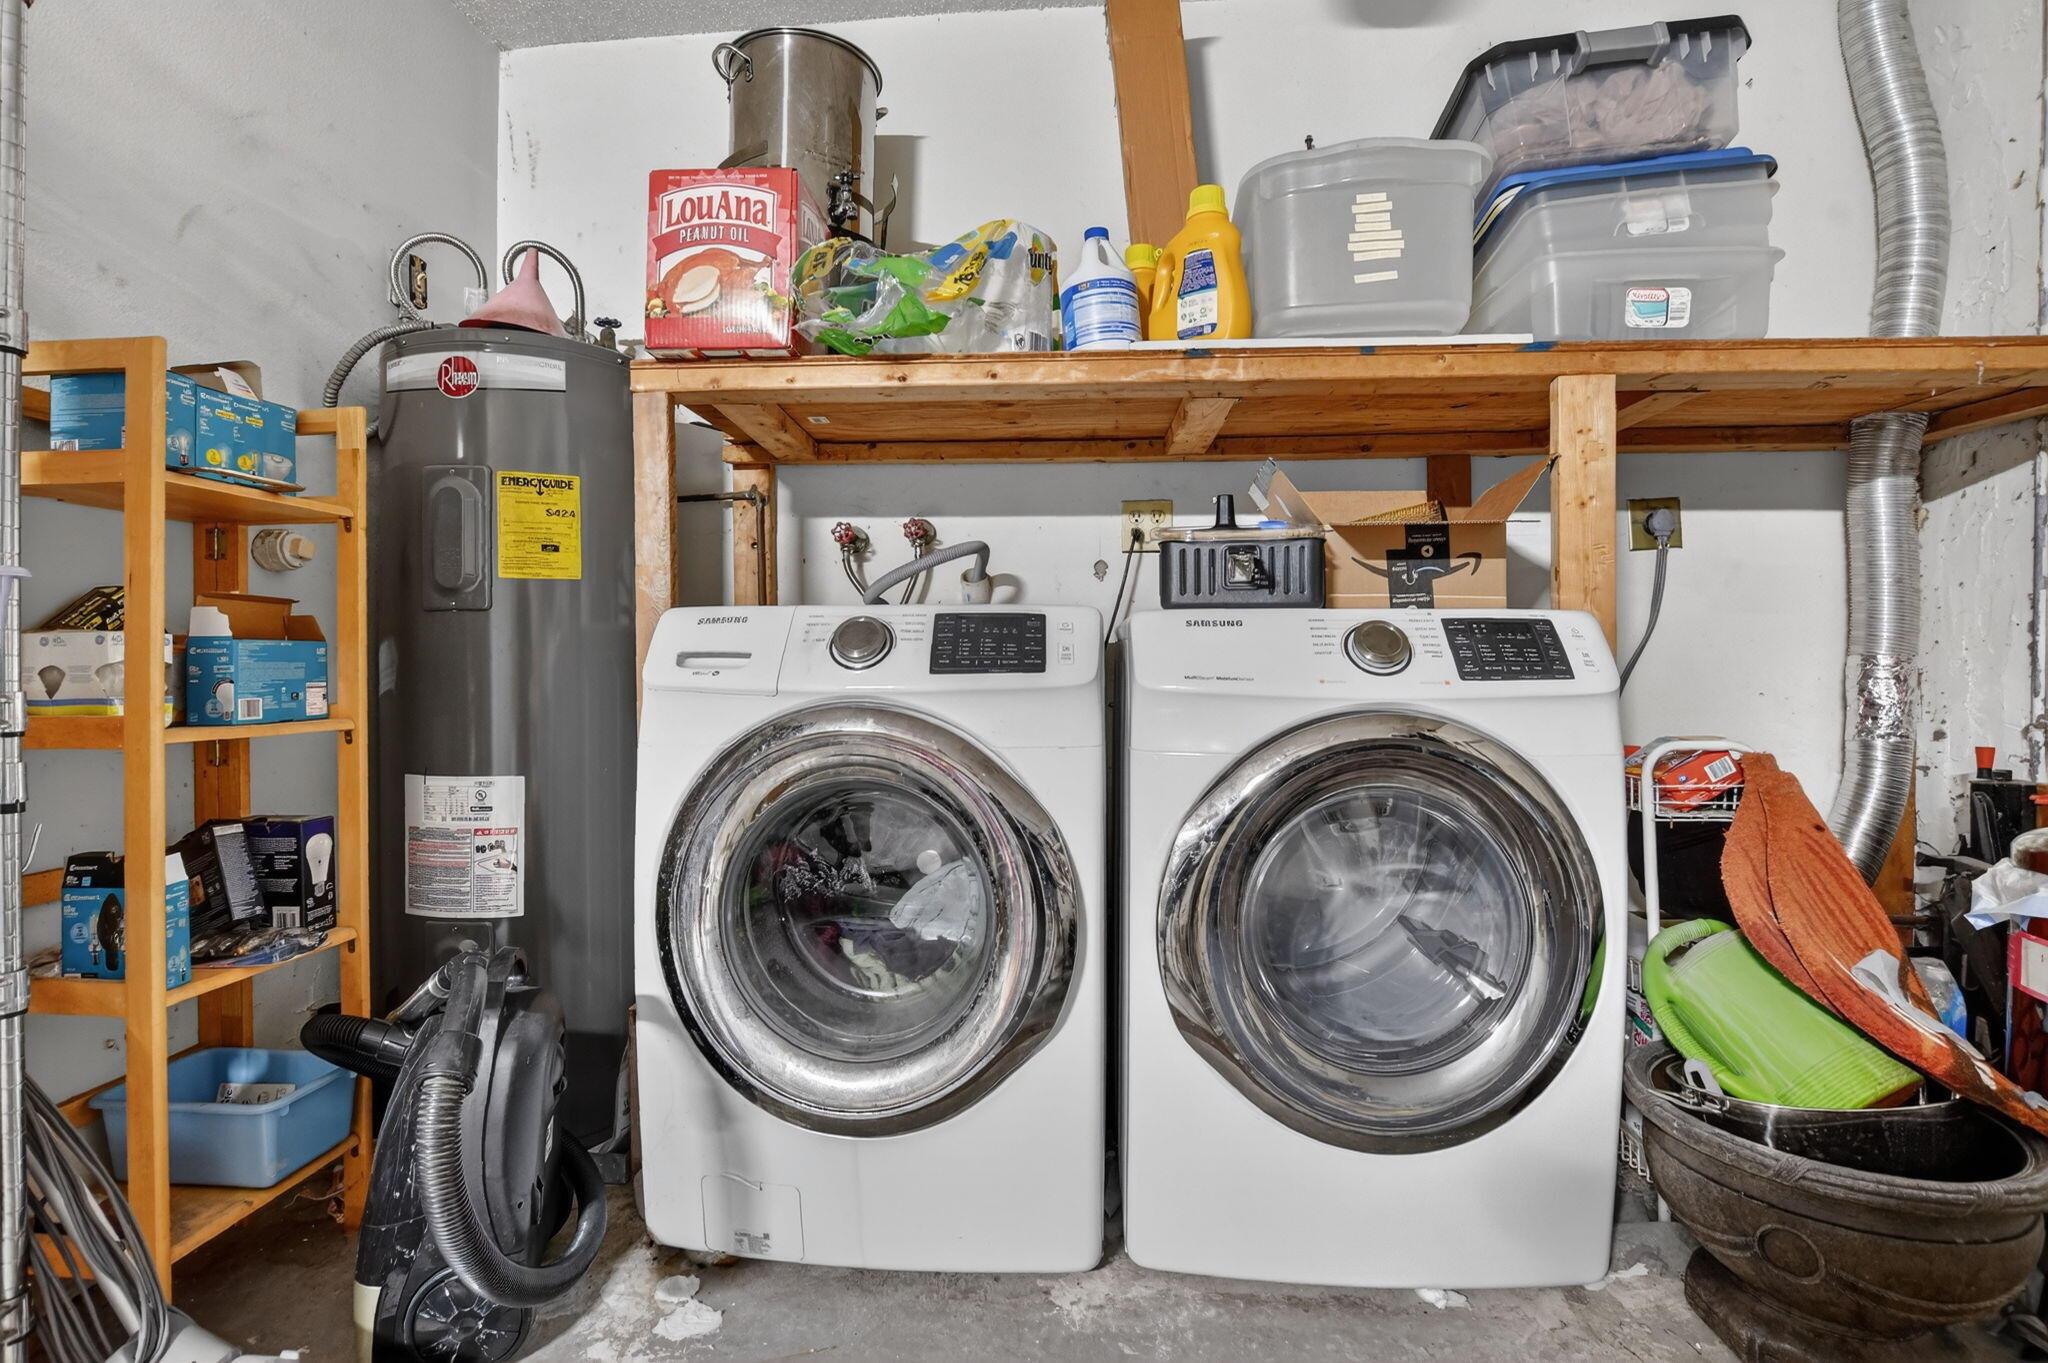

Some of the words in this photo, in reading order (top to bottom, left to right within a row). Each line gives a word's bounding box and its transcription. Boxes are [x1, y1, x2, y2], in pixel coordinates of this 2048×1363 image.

[679, 224, 724, 243] PEANUT
[730, 225, 749, 242] OIL
[441, 356, 477, 391] Rheem
[697, 616, 749, 625] SAMSUNG
[1185, 619, 1243, 627] SAMSUNG
